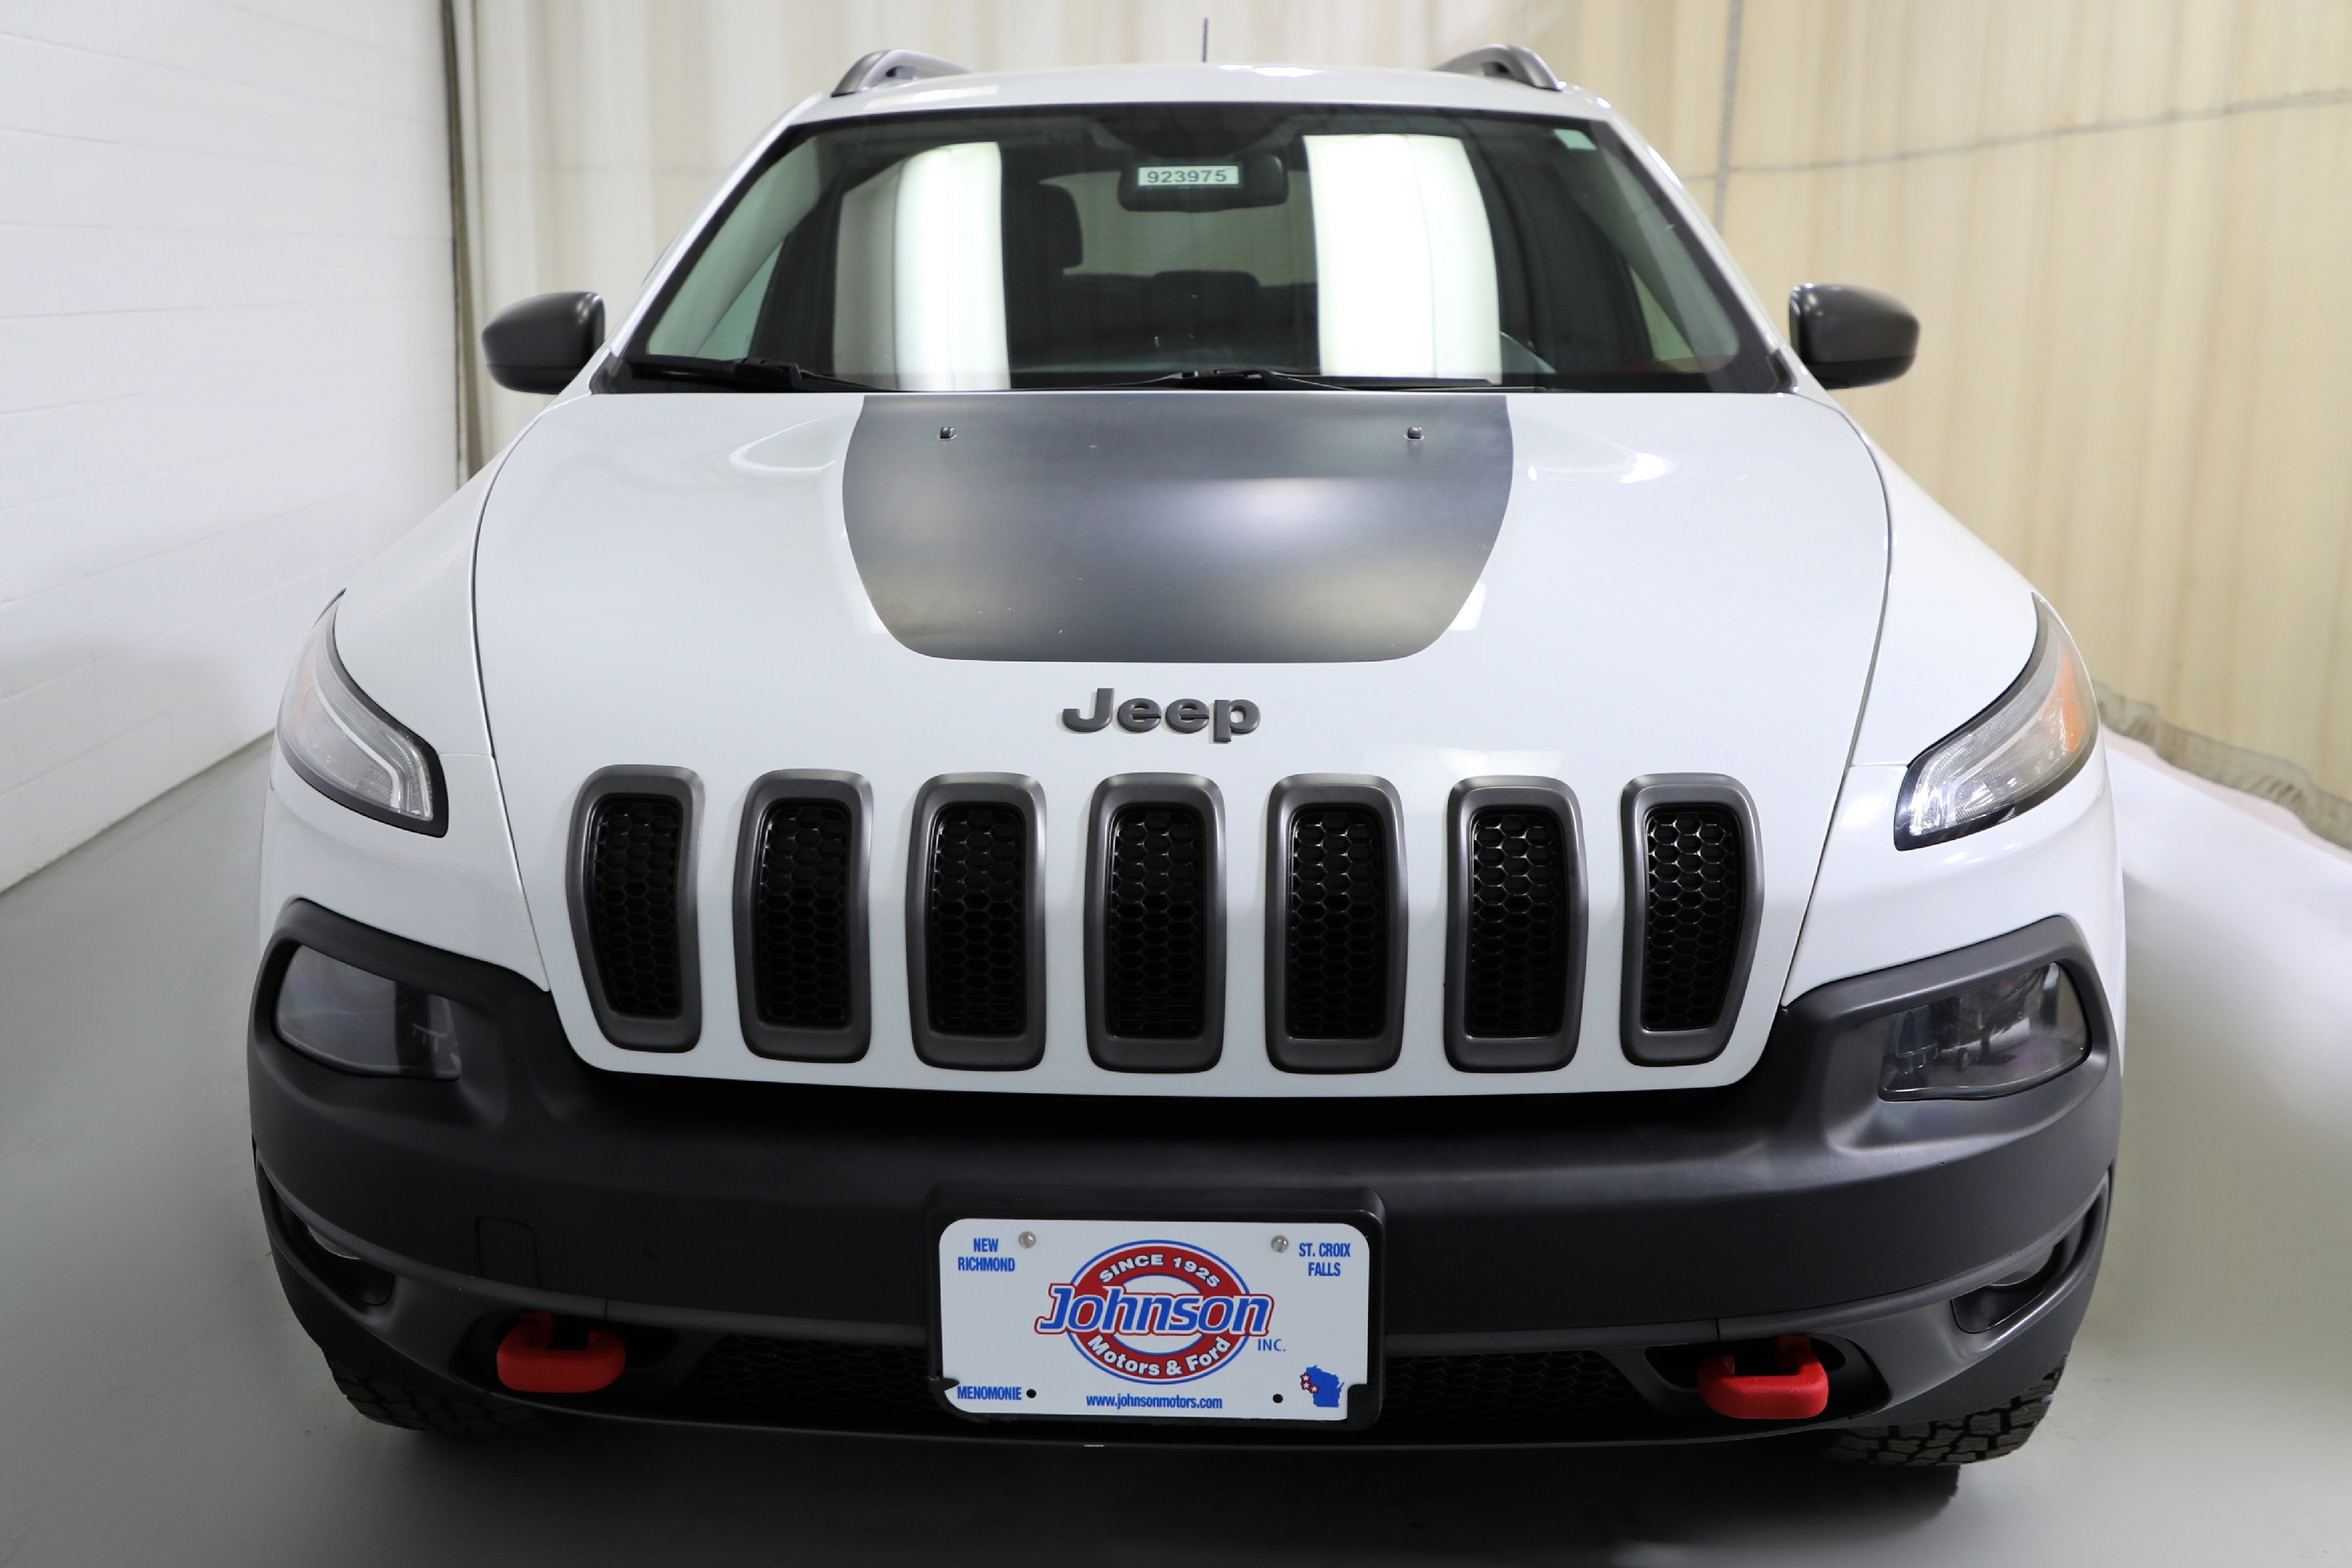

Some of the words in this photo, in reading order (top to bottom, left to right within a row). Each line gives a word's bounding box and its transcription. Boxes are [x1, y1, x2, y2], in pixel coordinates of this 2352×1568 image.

[1146, 170, 1227, 183] 923975
[1062, 688, 1261, 742] Jeep
[973, 1238, 999, 1253] NEW
[1299, 1242, 1316, 1257] ST.
[1318, 1243, 1351, 1258] CROIX
[957, 1257, 1015, 1272] RICHMOND
[1099, 1253, 1164, 1283] SINCE
[1173, 1257, 1221, 1288] 1925
[1308, 1262, 1341, 1277] FALLS
[1037, 1285, 1271, 1334] Johnson
[1258, 1338, 1286, 1352] INC.
[1087, 1334, 1160, 1376] Motors
[1166, 1360, 1183, 1376] &
[1185, 1336, 1231, 1371] Ford
[957, 1386, 1022, 1400] MENOMONIE
[1086, 1394, 1222, 1409] www.johnsonmotors.com
